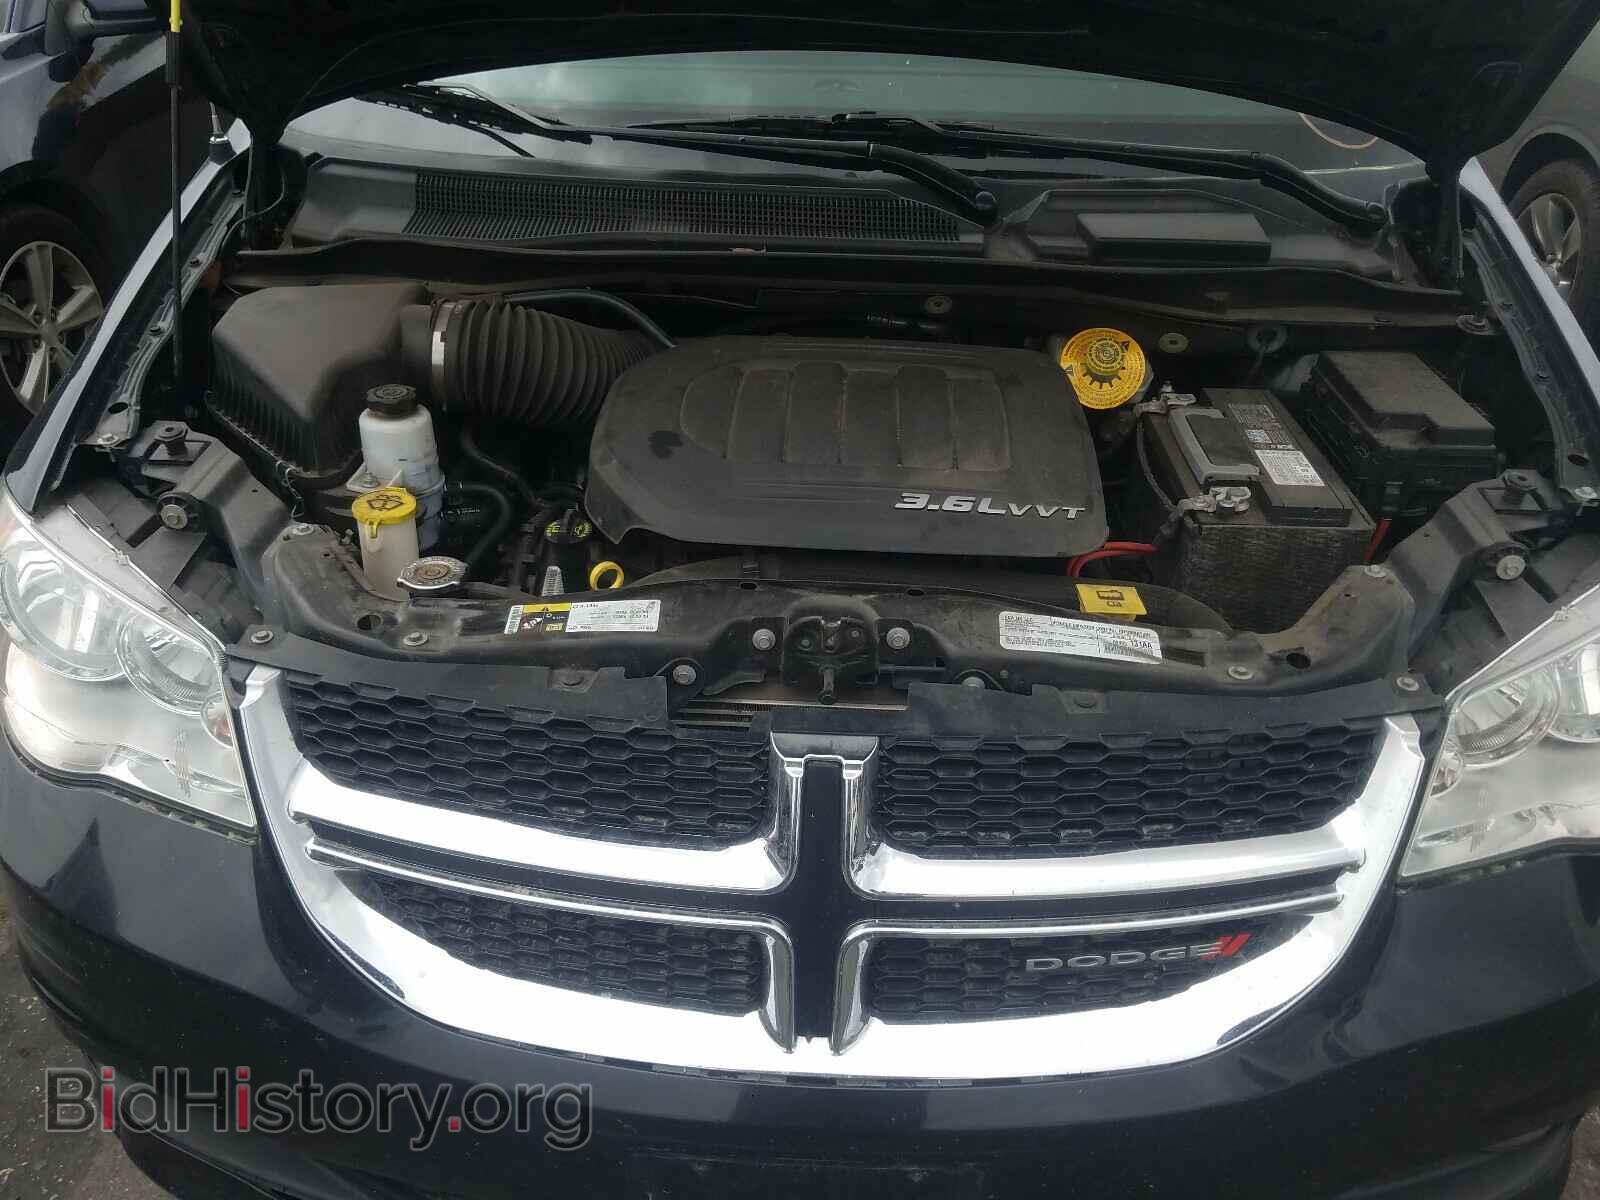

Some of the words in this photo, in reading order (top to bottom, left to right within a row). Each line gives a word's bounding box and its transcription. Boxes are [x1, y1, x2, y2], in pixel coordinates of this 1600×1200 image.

[894, 492, 1006, 515] 3.6L
[1007, 502, 1086, 519] VVT
[1025, 941, 1223, 971] DODGE
